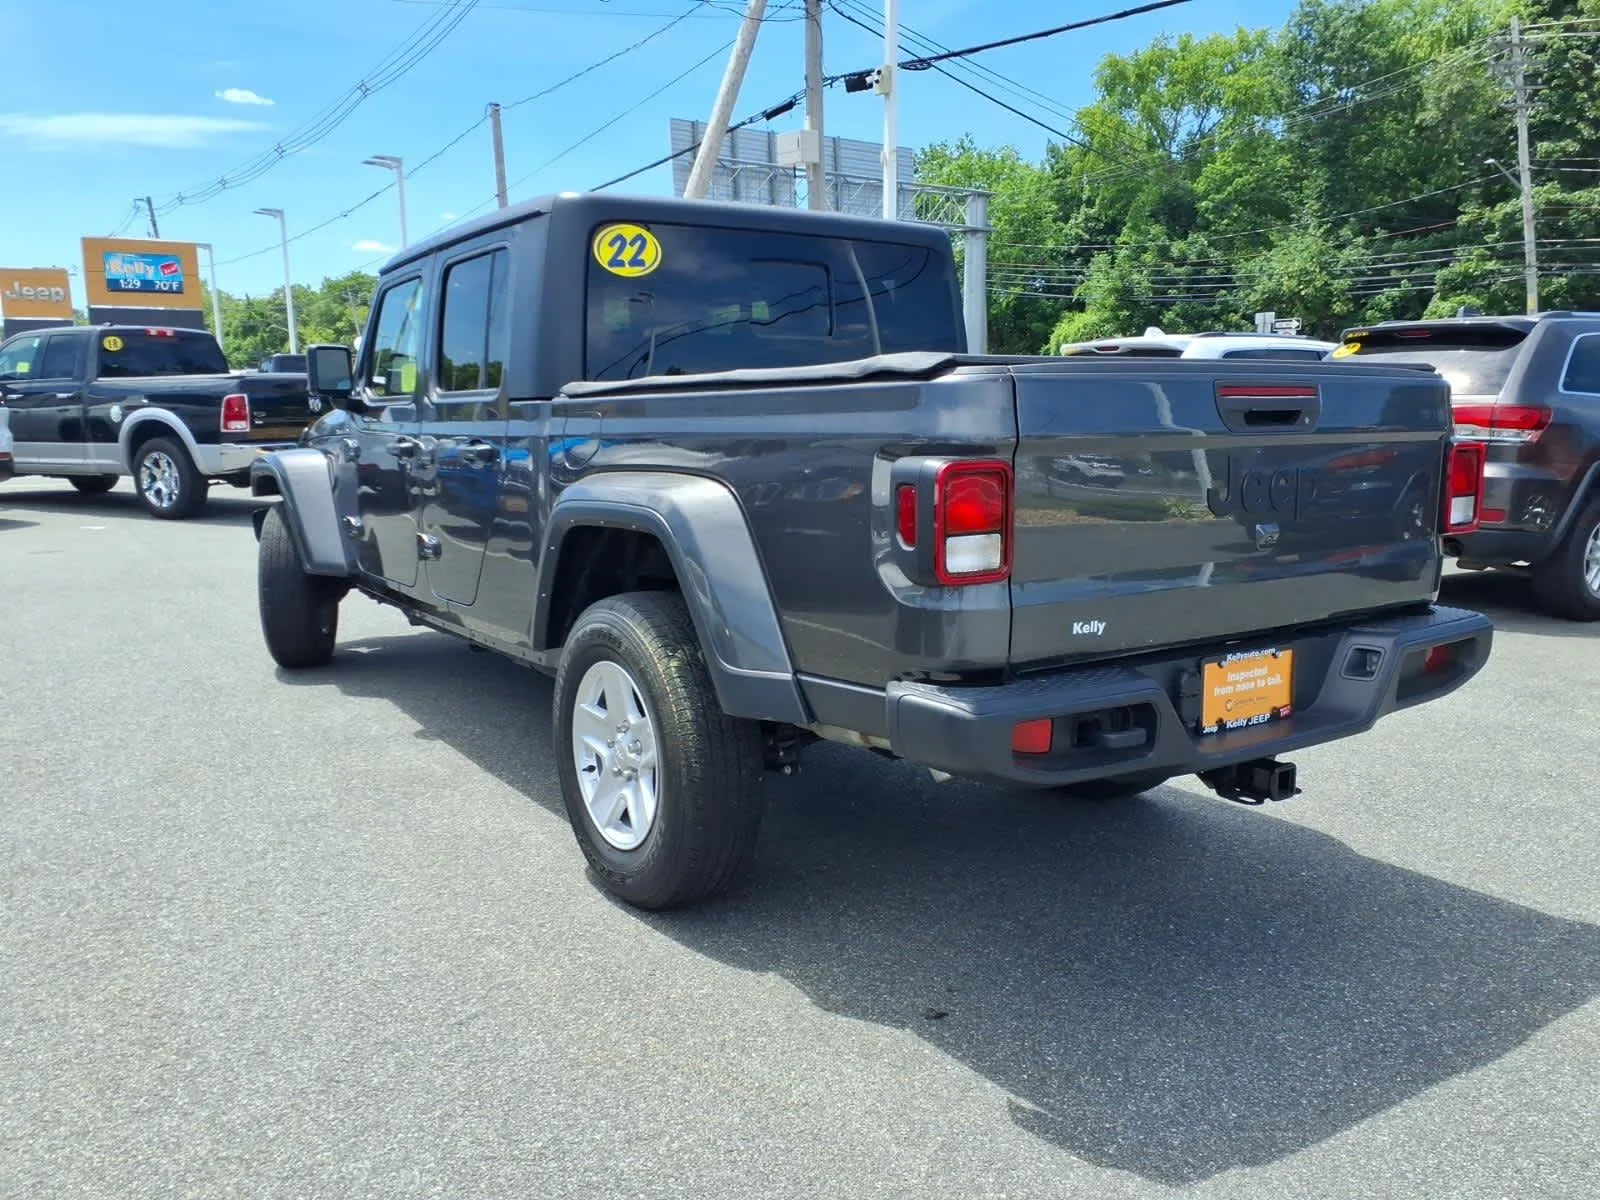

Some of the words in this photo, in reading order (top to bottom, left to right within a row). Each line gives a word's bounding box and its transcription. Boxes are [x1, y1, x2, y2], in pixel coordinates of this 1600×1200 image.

[608, 233, 647, 268] 22
[5, 280, 65, 303] Jeep
[1072, 620, 1106, 636] Kelly
[1226, 718, 1248, 729] Kelly
[1248, 714, 1271, 726] JEEP
